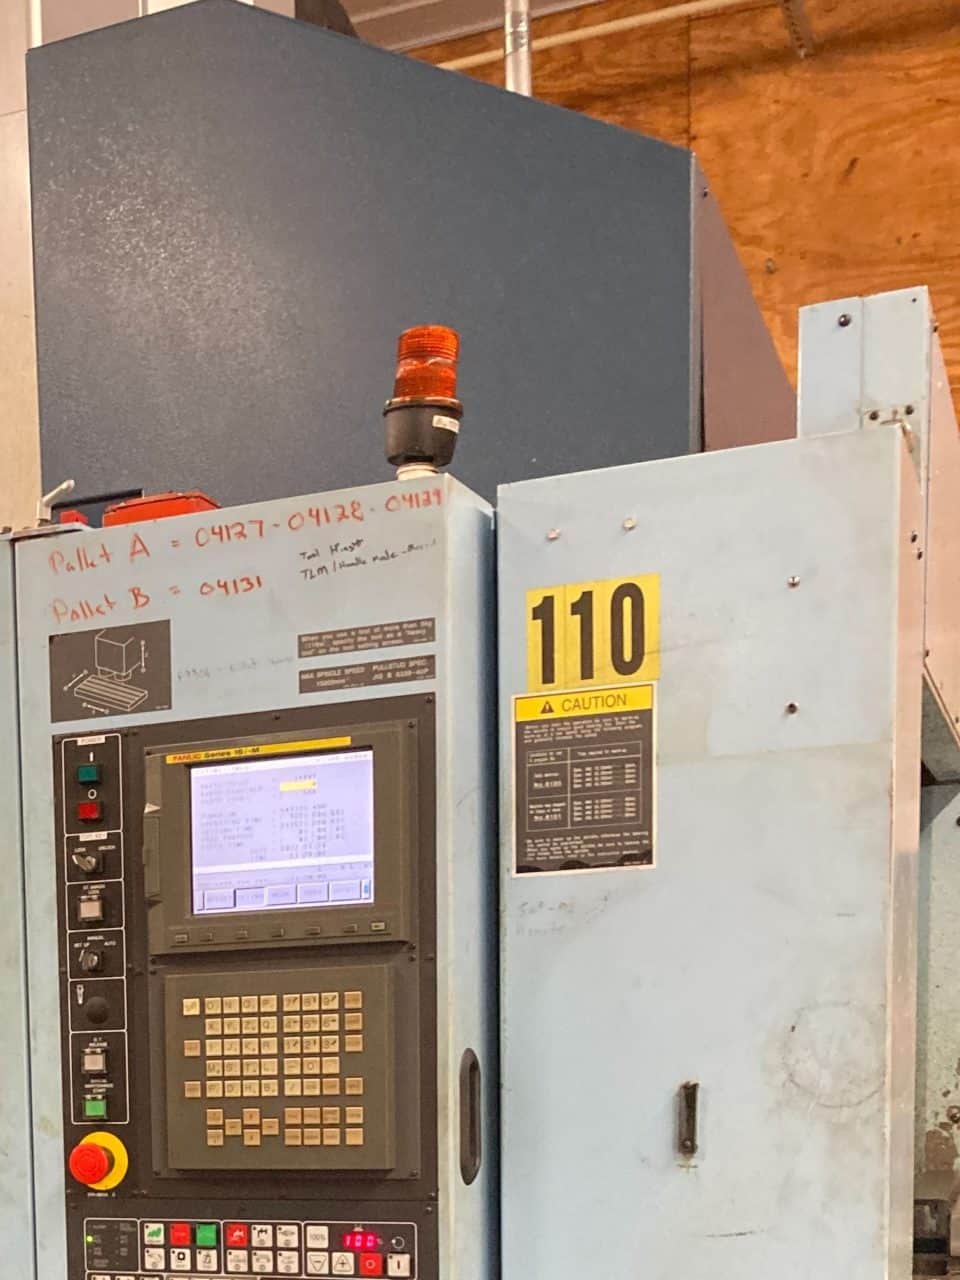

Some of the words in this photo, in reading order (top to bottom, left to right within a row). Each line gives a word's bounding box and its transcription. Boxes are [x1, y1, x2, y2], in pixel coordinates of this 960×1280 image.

[49, 543, 112, 575] Pallet
[129, 533, 150, 561] A
[52, 594, 117, 624] Pallet
[128, 587, 151, 609] B
[531, 581, 645, 685] 110
[561, 693, 627, 712] CAUTION
[173, 752, 201, 763] FANUC
[344, 1235, 375, 1248] 100
